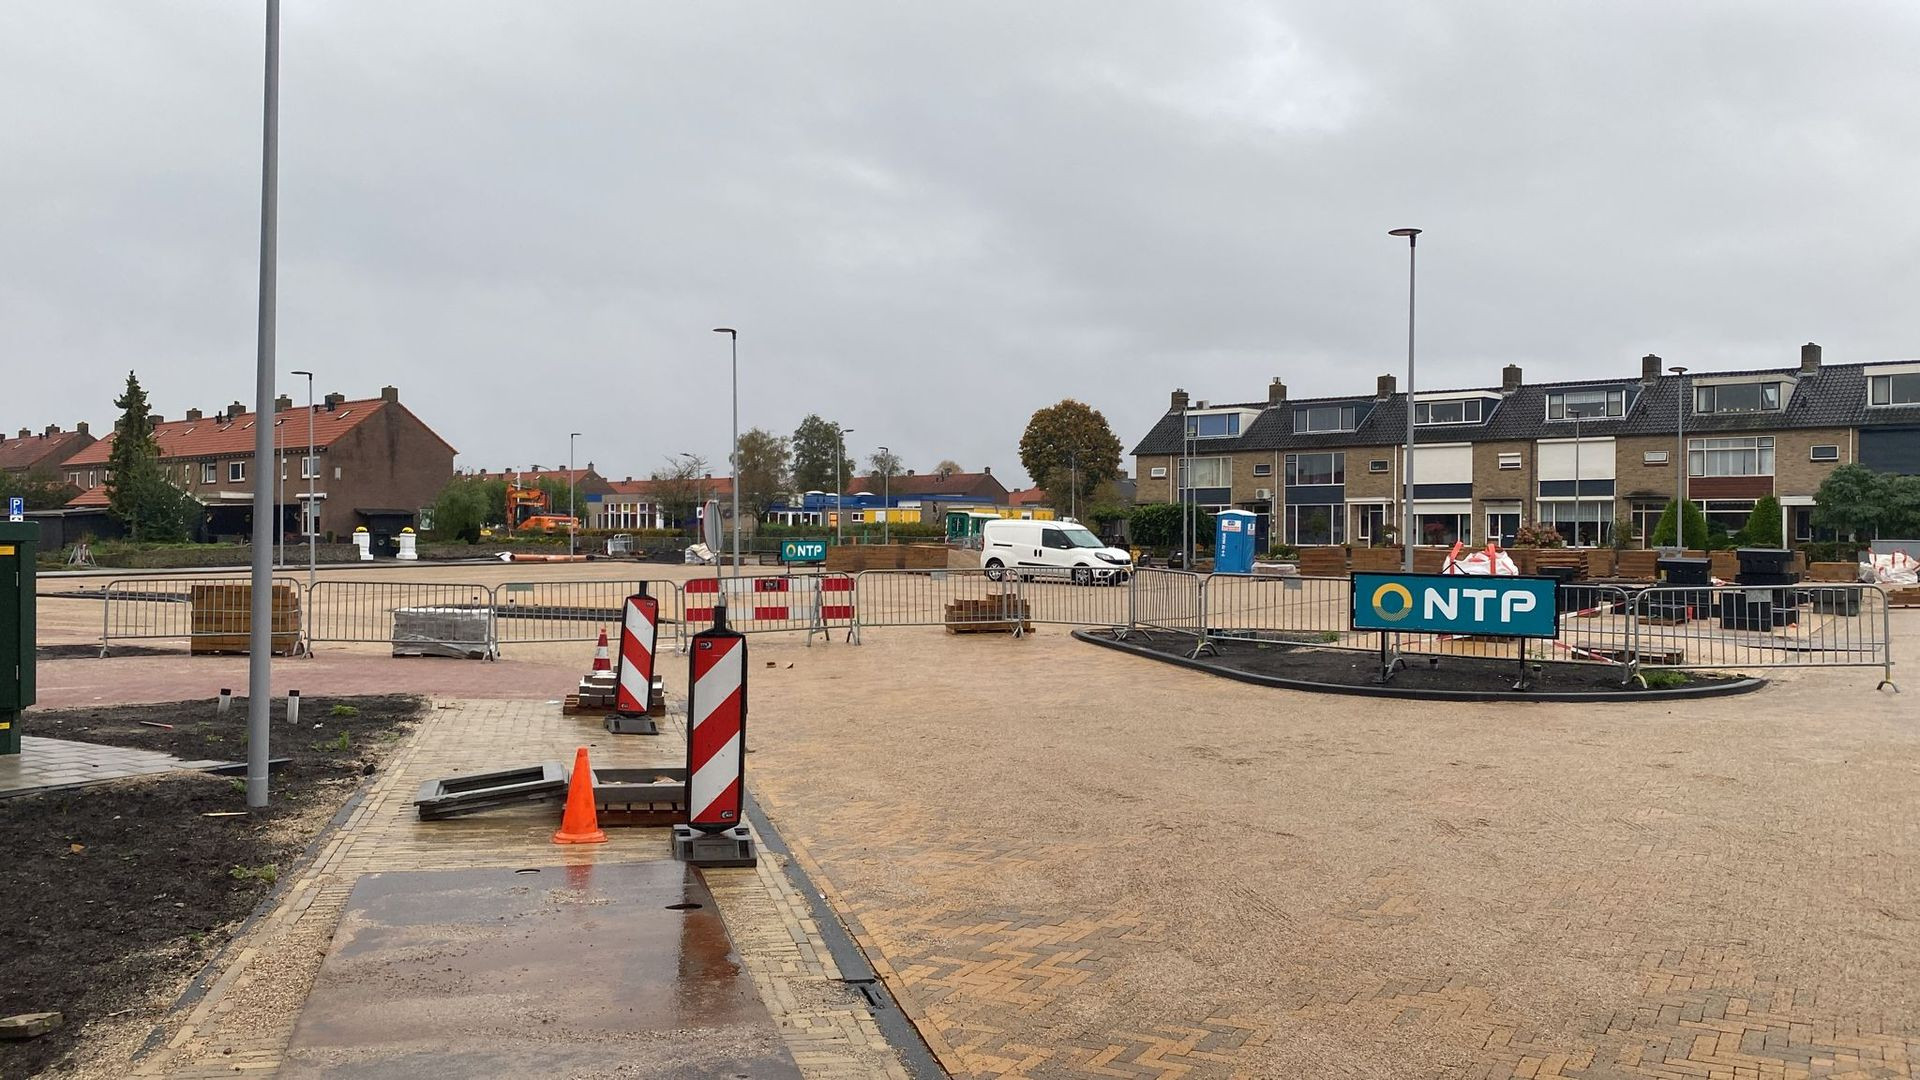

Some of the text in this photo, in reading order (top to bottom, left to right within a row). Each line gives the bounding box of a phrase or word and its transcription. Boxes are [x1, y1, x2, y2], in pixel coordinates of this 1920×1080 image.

[13, 499, 20, 509] P
[797, 544, 822, 557] NTP
[1423, 587, 1537, 623] NTP
